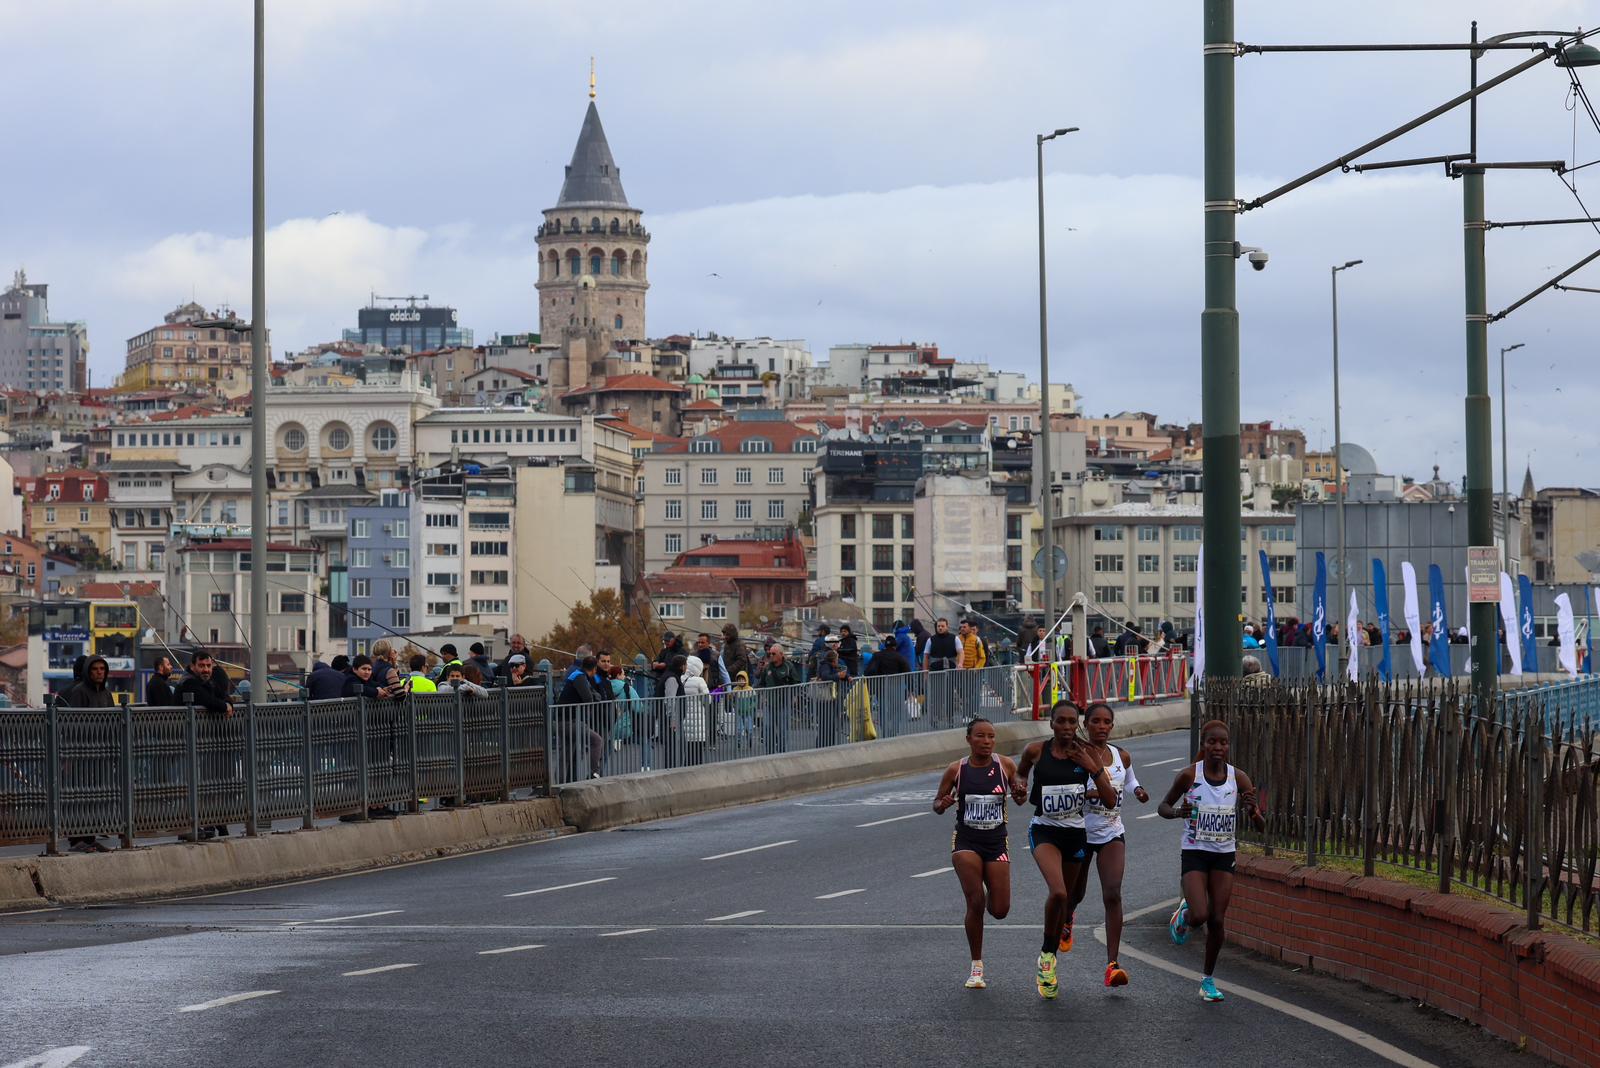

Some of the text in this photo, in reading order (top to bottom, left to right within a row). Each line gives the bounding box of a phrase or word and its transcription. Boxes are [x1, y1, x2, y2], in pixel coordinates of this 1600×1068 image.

[1470, 559, 1497, 567] TRAMVAY
[1044, 793, 1084, 812] GLADYS
[1198, 813, 1235, 832] MARGARET
